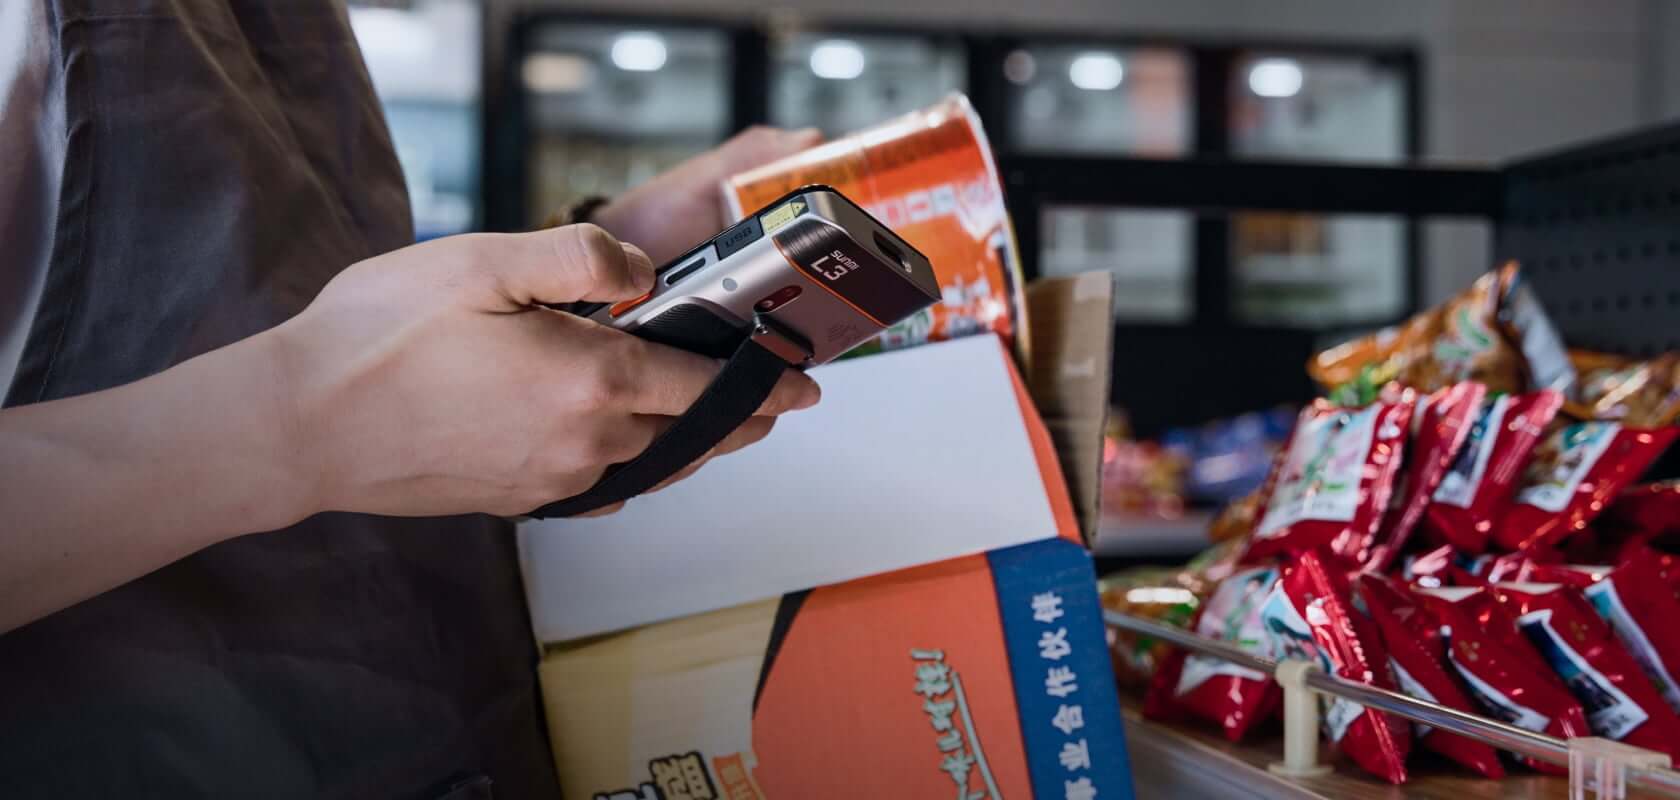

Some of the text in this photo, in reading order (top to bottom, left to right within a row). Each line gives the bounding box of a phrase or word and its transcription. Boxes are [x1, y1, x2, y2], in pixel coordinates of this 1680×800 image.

[725, 226, 753, 248] USB
[810, 255, 849, 281] L3
[1031, 591, 1098, 800] 事业合作伙伴
